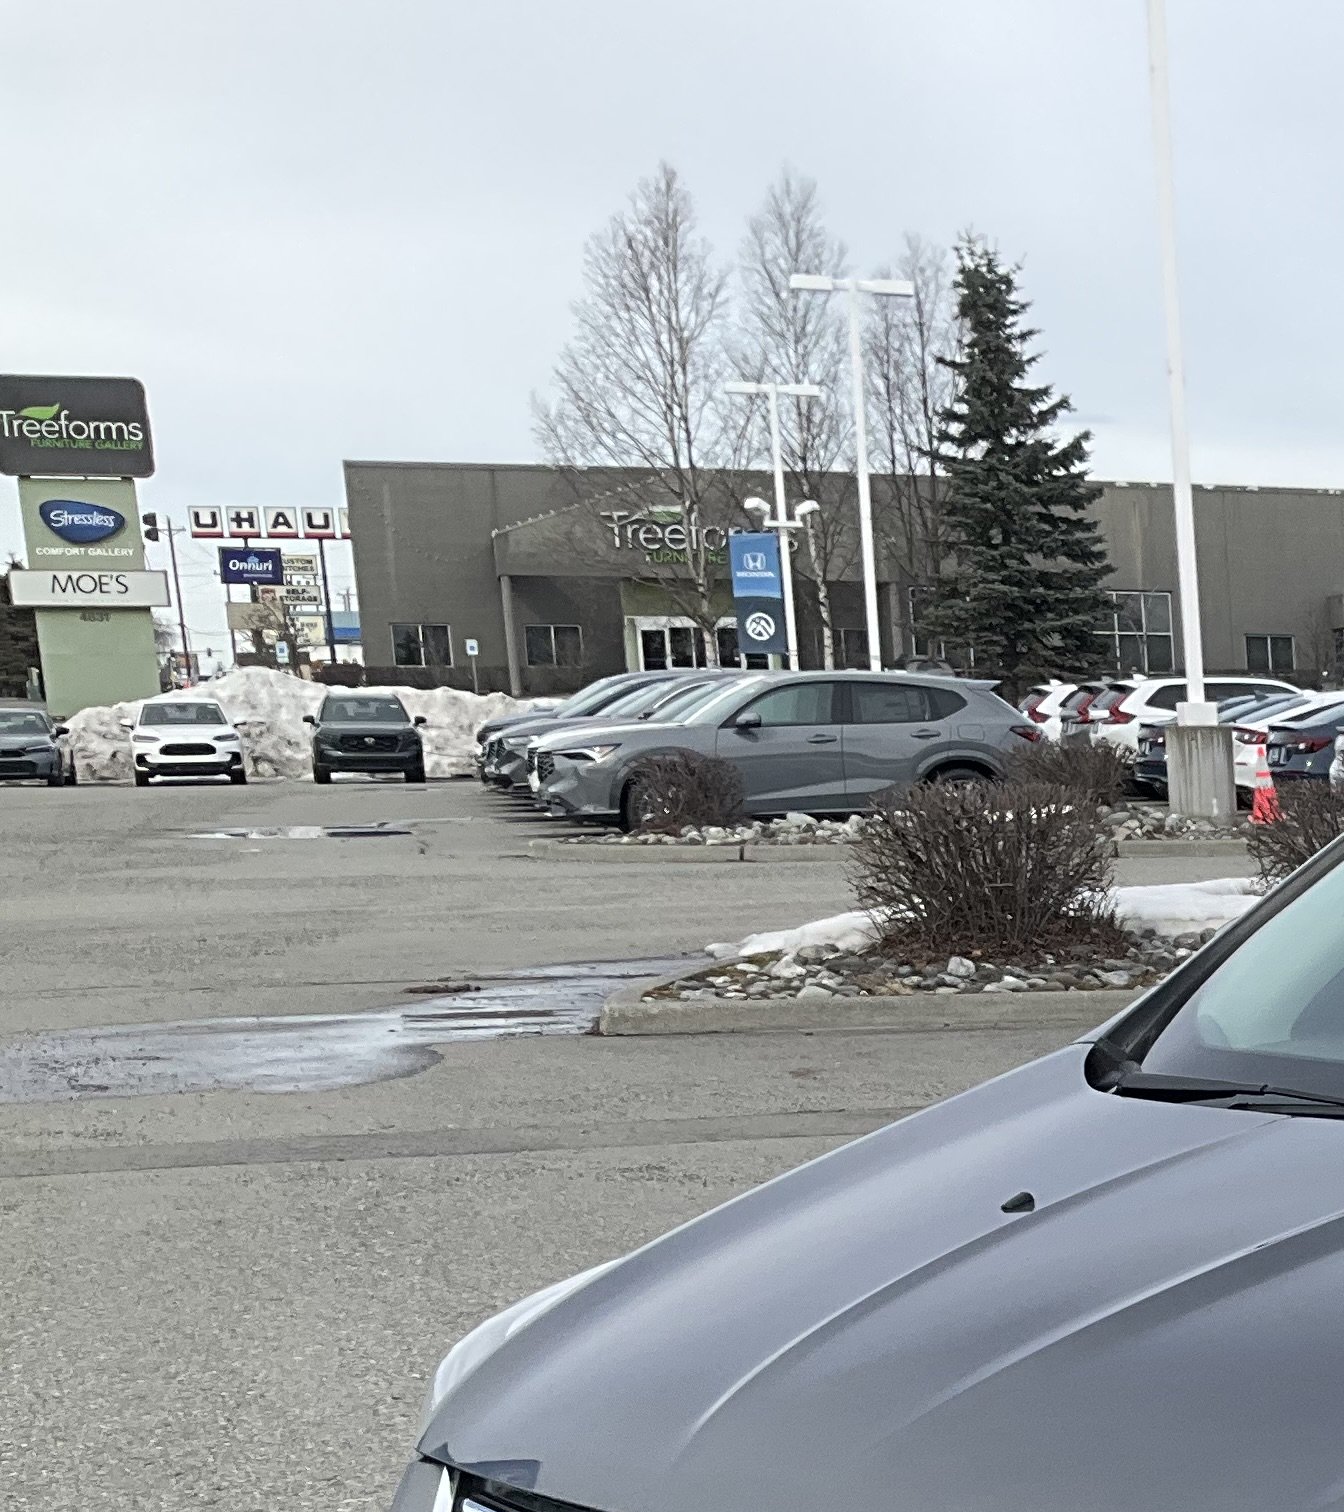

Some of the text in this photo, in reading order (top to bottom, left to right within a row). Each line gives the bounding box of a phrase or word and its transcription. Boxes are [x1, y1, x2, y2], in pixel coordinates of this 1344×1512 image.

[0, 410, 143, 441] Treeforms
[30, 439, 143, 450] FURNITURE GALLERY
[50, 510, 115, 527] Stressless
[36, 547, 134, 556] COMFORT GALLERY
[229, 559, 273, 571] Onnuri
[51, 574, 129, 594] MOE'S
